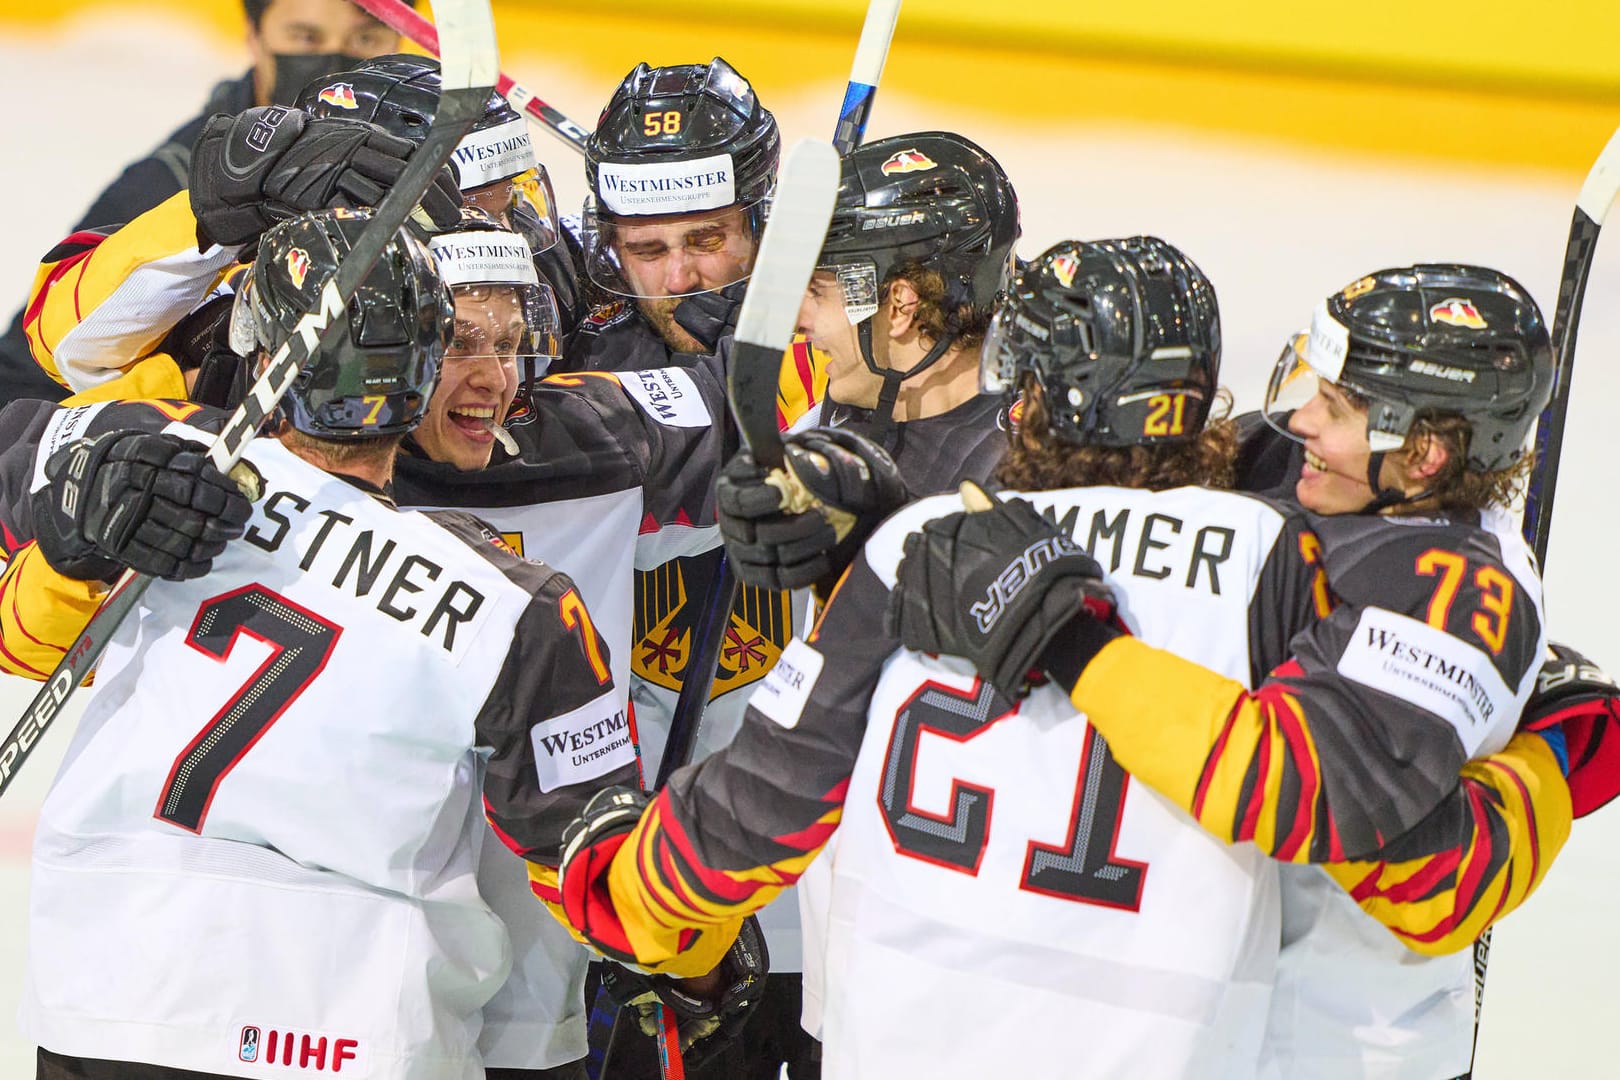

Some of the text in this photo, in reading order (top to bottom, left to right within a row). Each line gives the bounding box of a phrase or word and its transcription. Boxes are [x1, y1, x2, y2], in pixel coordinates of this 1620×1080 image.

[643, 110, 682, 138] 58
[603, 170, 728, 194] WESTMINSTER
[861, 212, 926, 232] BAUER
[204, 277, 346, 477] CCM
[1408, 359, 1477, 385] BAUER
[362, 394, 387, 425] 7
[1143, 392, 1185, 438] 21
[243, 491, 486, 653] STNER
[1415, 547, 1515, 656] 73
[559, 587, 611, 686] 7
[153, 581, 345, 836] 7
[876, 674, 1150, 914] 21
[266, 1029, 359, 1073] IIHF
